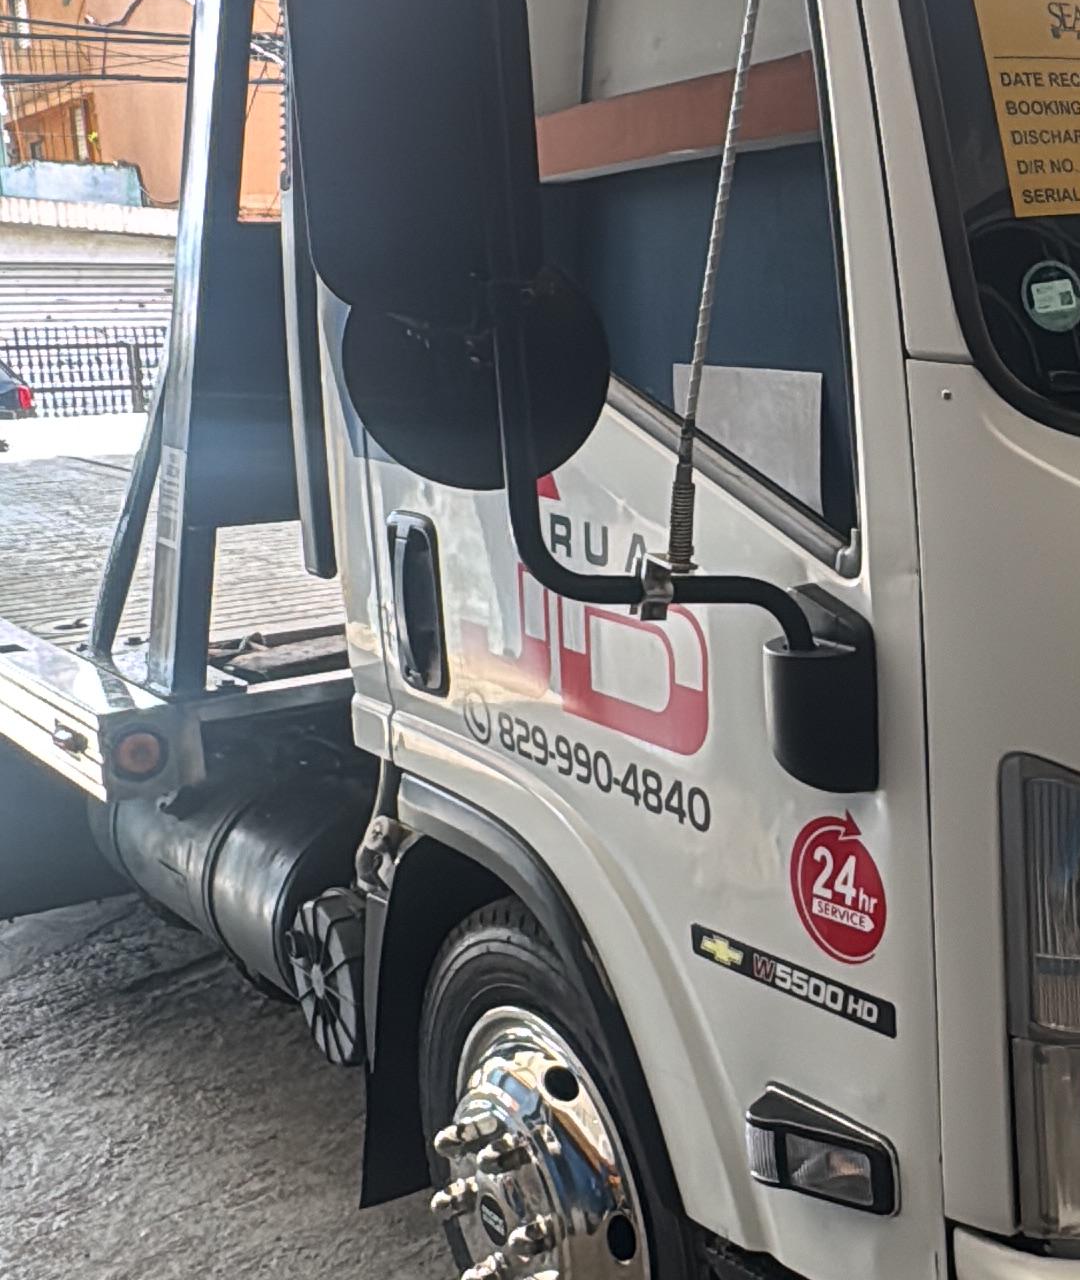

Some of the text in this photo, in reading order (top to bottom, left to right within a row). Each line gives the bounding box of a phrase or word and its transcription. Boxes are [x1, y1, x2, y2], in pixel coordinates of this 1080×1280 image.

[1000, 71, 1043, 88] DATE
[498, 711, 712, 833] 829-990-4840
[816, 901, 867, 928] SERVICE
[752, 951, 879, 1024] W5500 HD
